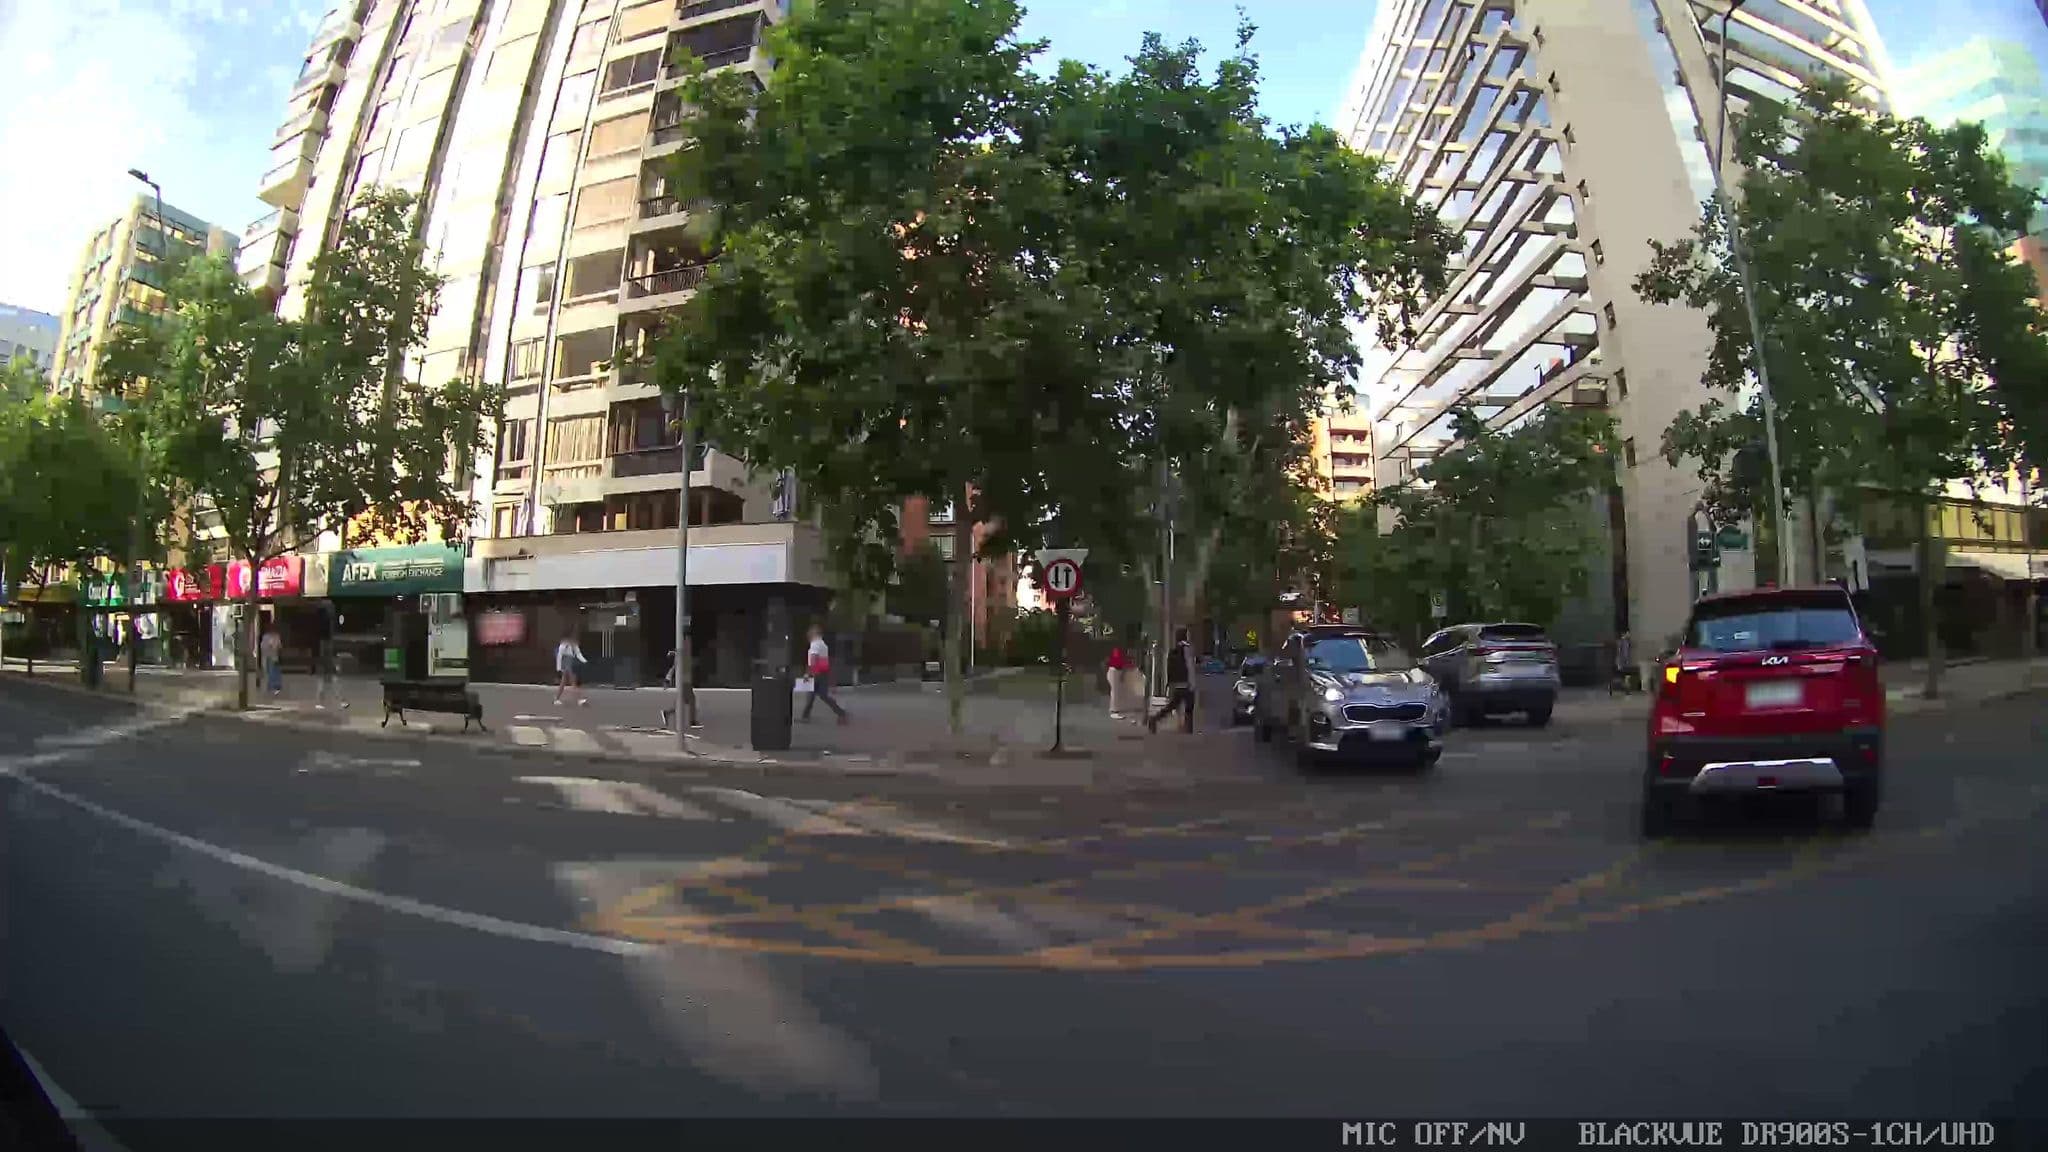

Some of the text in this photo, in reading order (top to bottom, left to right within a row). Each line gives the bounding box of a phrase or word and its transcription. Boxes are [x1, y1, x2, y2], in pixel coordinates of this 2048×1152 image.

[342, 562, 377, 582] AFEX
[408, 567, 445, 577] EXCHANGE
[1761, 655, 1789, 665] KIA
